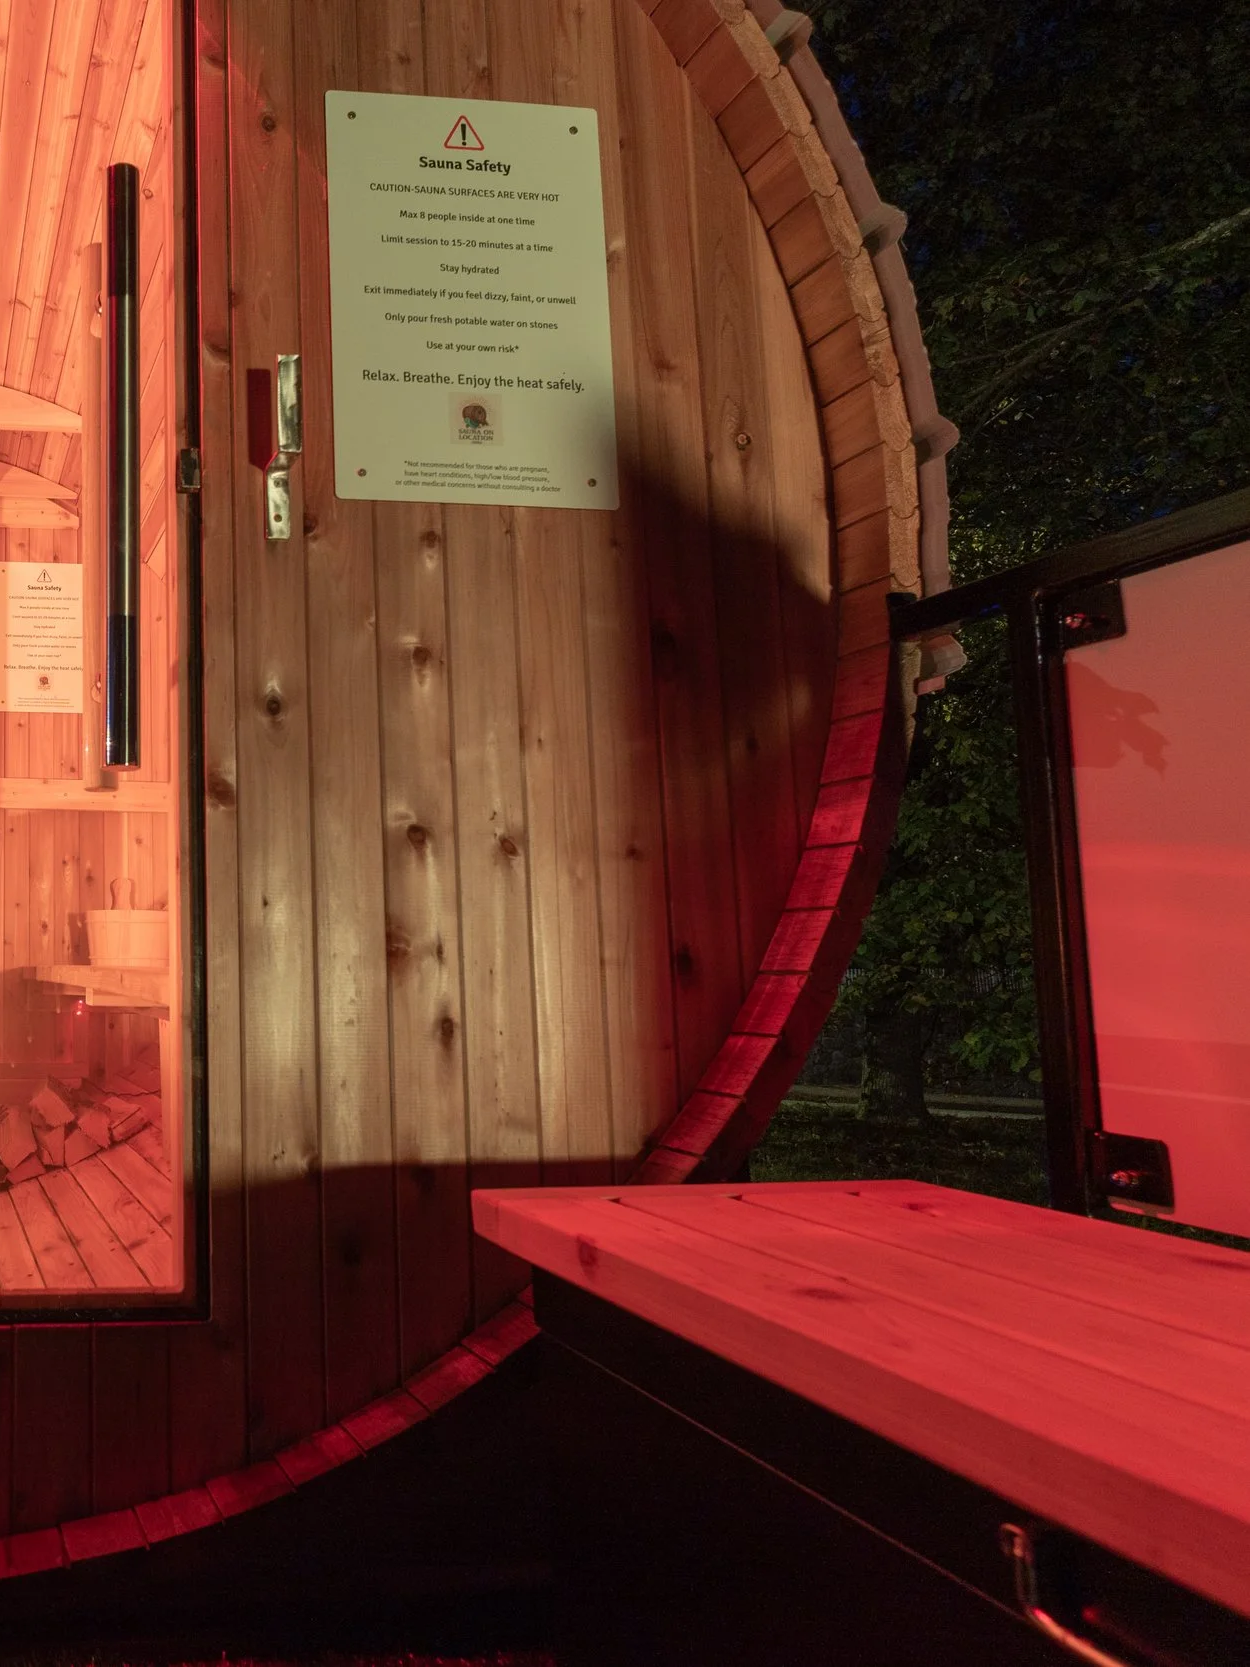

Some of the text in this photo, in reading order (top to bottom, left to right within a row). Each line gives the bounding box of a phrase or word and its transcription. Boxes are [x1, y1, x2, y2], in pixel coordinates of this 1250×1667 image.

[419, 156, 511, 176] Sauna Safety
[370, 182, 560, 202] CAUTION-SAUNA SURFACES ARE VERY HOT
[399, 210, 418, 219] Max
[420, 211, 426, 220] 8
[427, 212, 457, 222] people
[459, 213, 485, 223] inside
[497, 217, 514, 225] one
[515, 217, 535, 226] time
[381, 234, 403, 243] Limit
[406, 236, 438, 245] session
[440, 238, 449, 246] to
[452, 239, 477, 248] 15-20
[478, 240, 514, 250] minutes
[515, 243, 524, 251] at
[533, 244, 553, 253] time
[439, 263, 500, 275] Stay hydrated
[364, 285, 381, 294] Exit
[383, 286, 438, 299] immediately
[439, 289, 446, 298] if
[448, 290, 464, 299] you
[465, 290, 483, 299] feel
[484, 291, 509, 303] dizzy,
[510, 293, 534, 304] faint,
[547, 296, 577, 305] unwell
[384, 312, 559, 330] Only pour fresh potable water on stones
[426, 341, 443, 350] Use
[445, 342, 454, 350] at
[456, 343, 476, 352] your
[477, 344, 496, 353] own
[362, 369, 585, 394] Relax. Breathe. Enjoy the heat safely.
[458, 428, 482, 436] SAUNA
[502, 484, 535, 492] consulting
[540, 485, 561, 493] doctor
